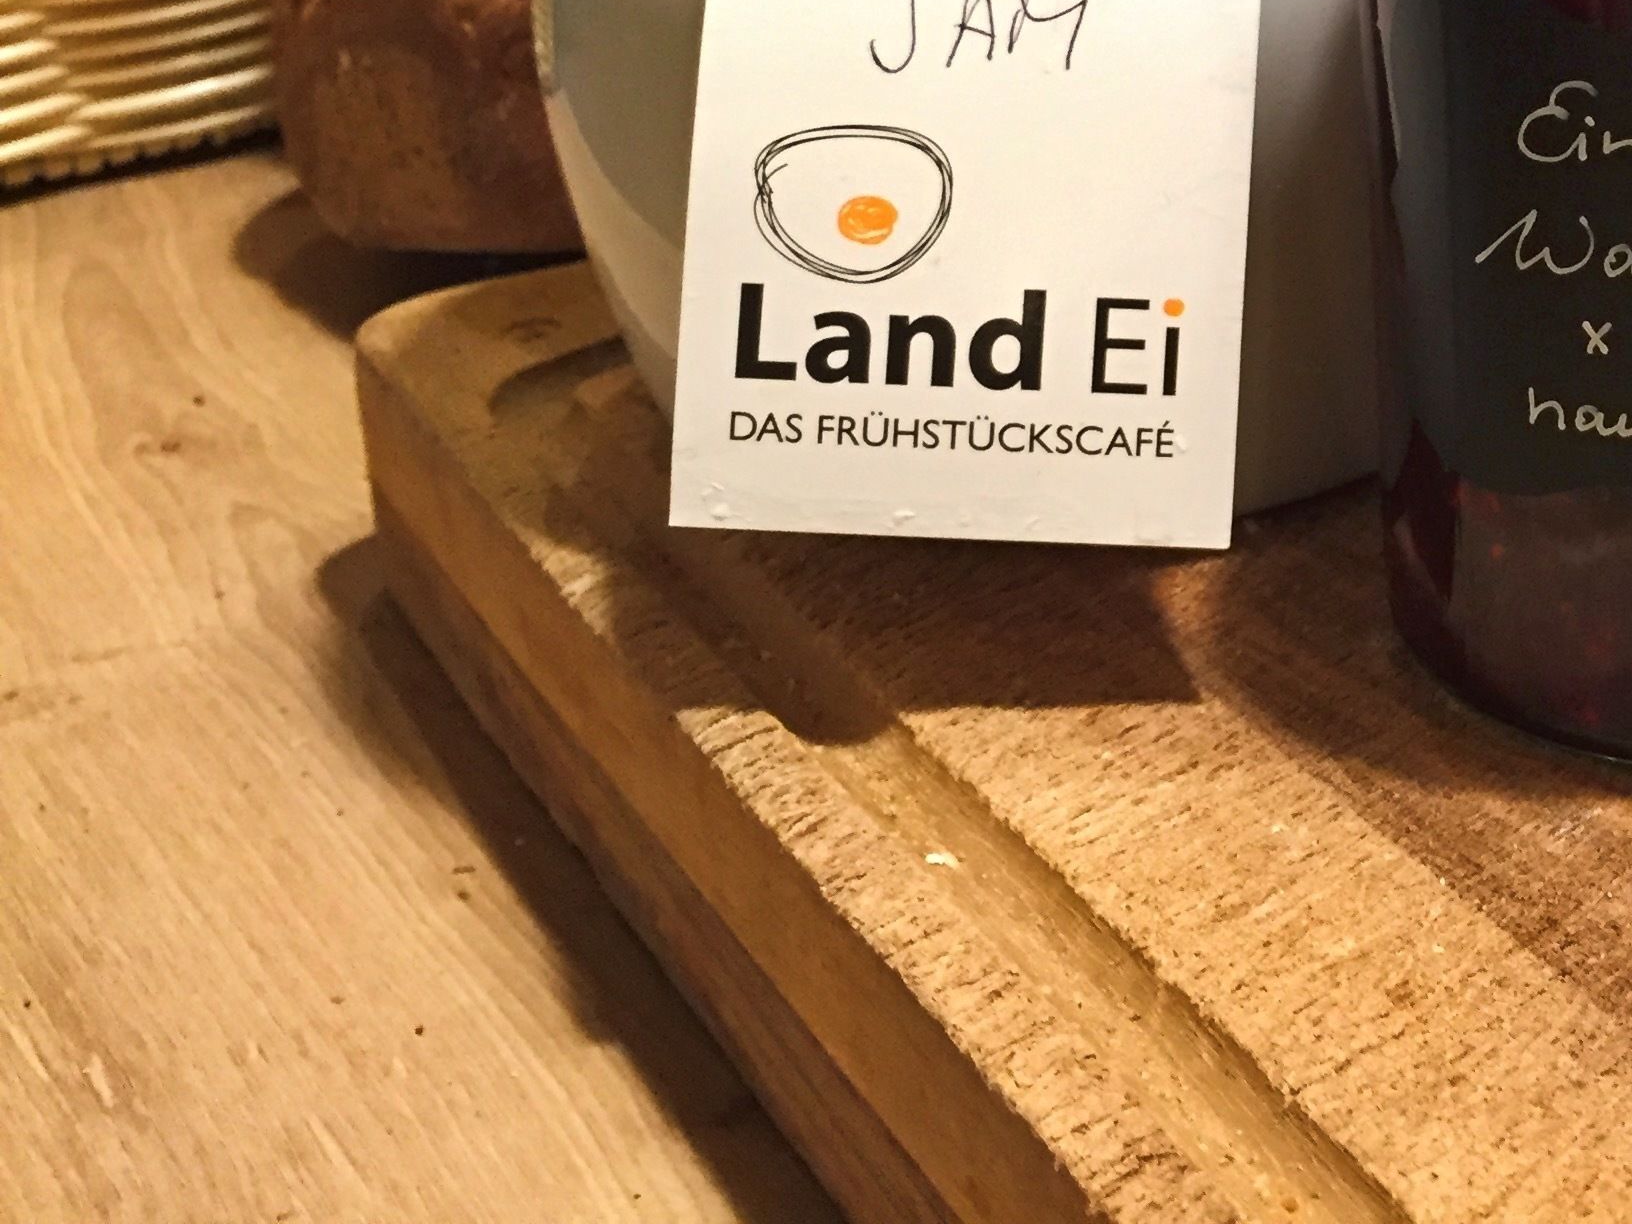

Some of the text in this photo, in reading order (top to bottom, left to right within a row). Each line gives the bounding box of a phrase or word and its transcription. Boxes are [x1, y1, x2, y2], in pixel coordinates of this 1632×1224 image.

[734, 282, 1186, 397] Land Ei
[728, 410, 1176, 459] DAS FRÜHSTÜCKSCAFÉ
